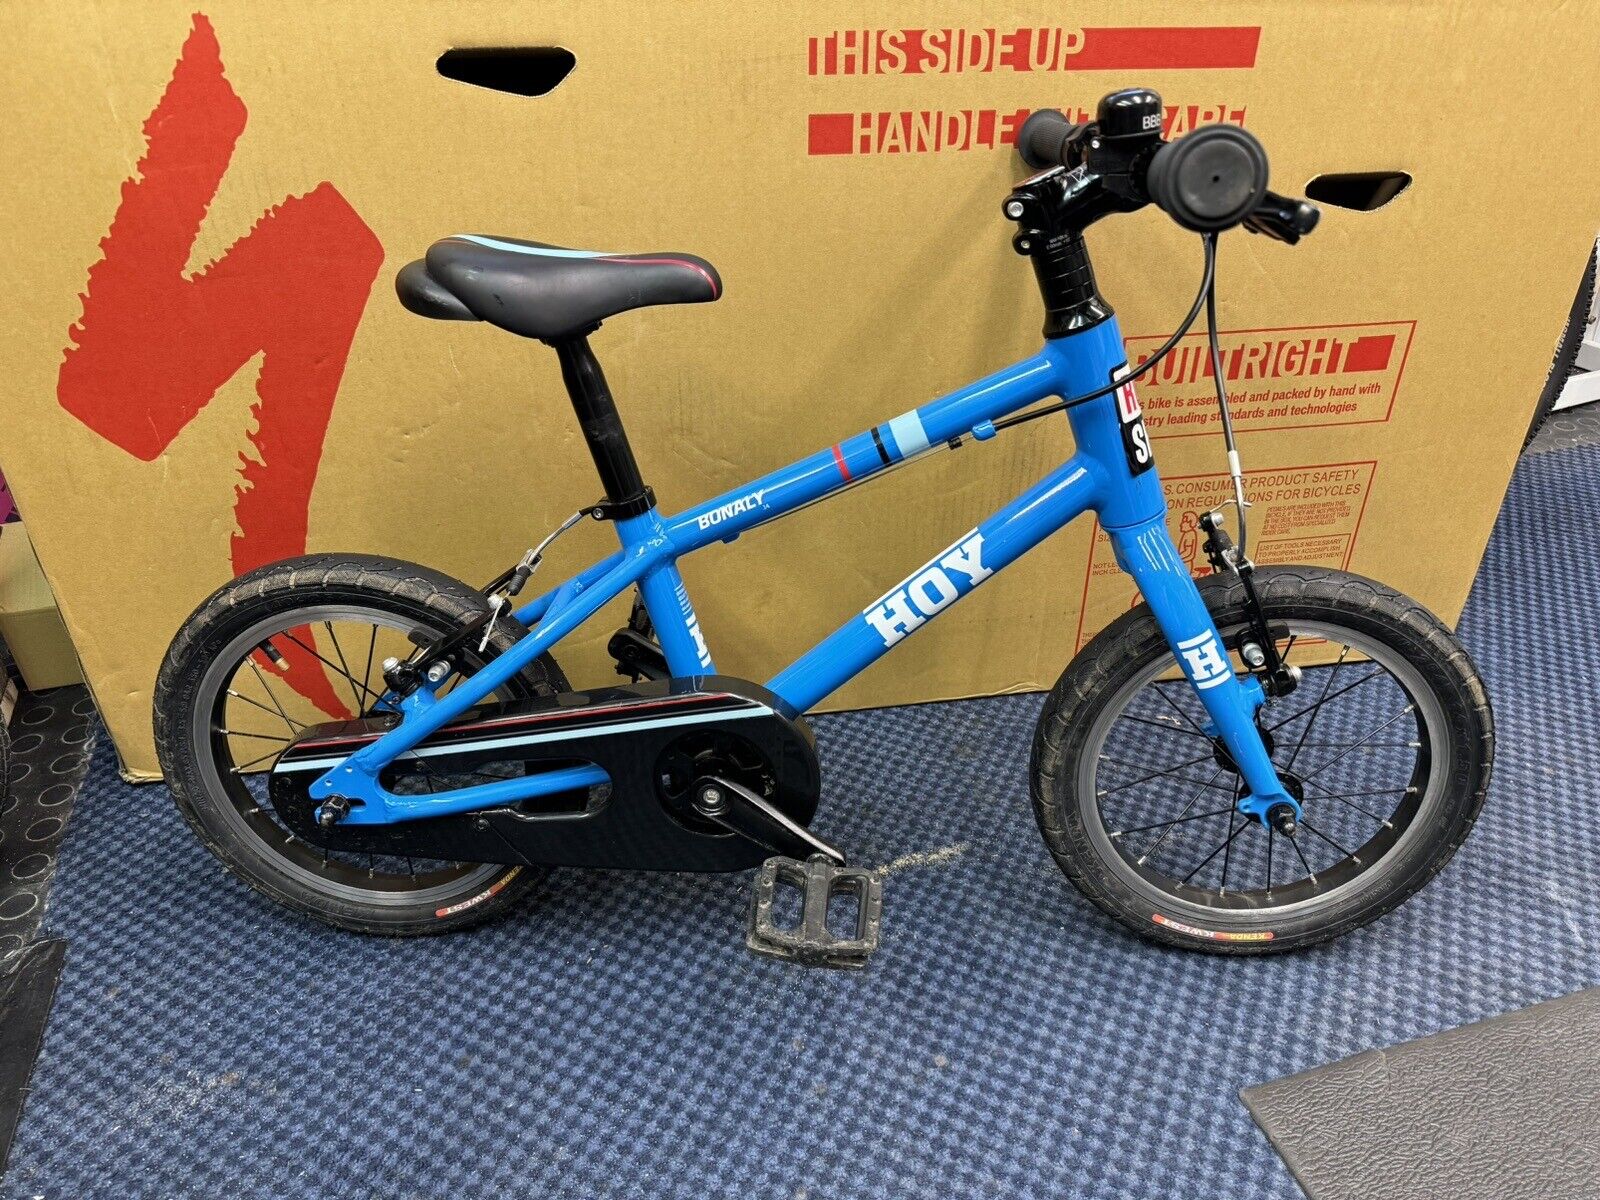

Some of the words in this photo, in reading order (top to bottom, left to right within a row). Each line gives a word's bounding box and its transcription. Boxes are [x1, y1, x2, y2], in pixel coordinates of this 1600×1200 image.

[808, 29, 907, 75] THIS
[918, 28, 1014, 74] SIDE
[1029, 27, 1087, 72] UP
[852, 108, 1018, 155] HANDLE
[1148, 396, 1171, 411] bike
[1175, 396, 1185, 408] is
[1249, 389, 1270, 402] and
[1272, 387, 1312, 403] packed
[1313, 386, 1327, 400] by
[1329, 383, 1357, 397] hand
[1358, 382, 1381, 395] with
[1167, 411, 1207, 426] leading
[1210, 406, 1265, 421] stndards
[1267, 404, 1288, 418] and
[1290, 401, 1358, 416] technologies
[1250, 473, 1310, 488] PRODUCT
[1312, 469, 1360, 483] SAFETY
[698, 489, 765, 531] BONALY
[1187, 491, 1273, 508] REGULIONS
[1275, 489, 1301, 501] FOR
[1302, 483, 1361, 499] BICYCLES
[1260, 544, 1273, 552] LIST
[864, 532, 993, 648] HOY
[1182, 638, 1228, 681] H
[1230, 932, 1266, 941] KENDA
